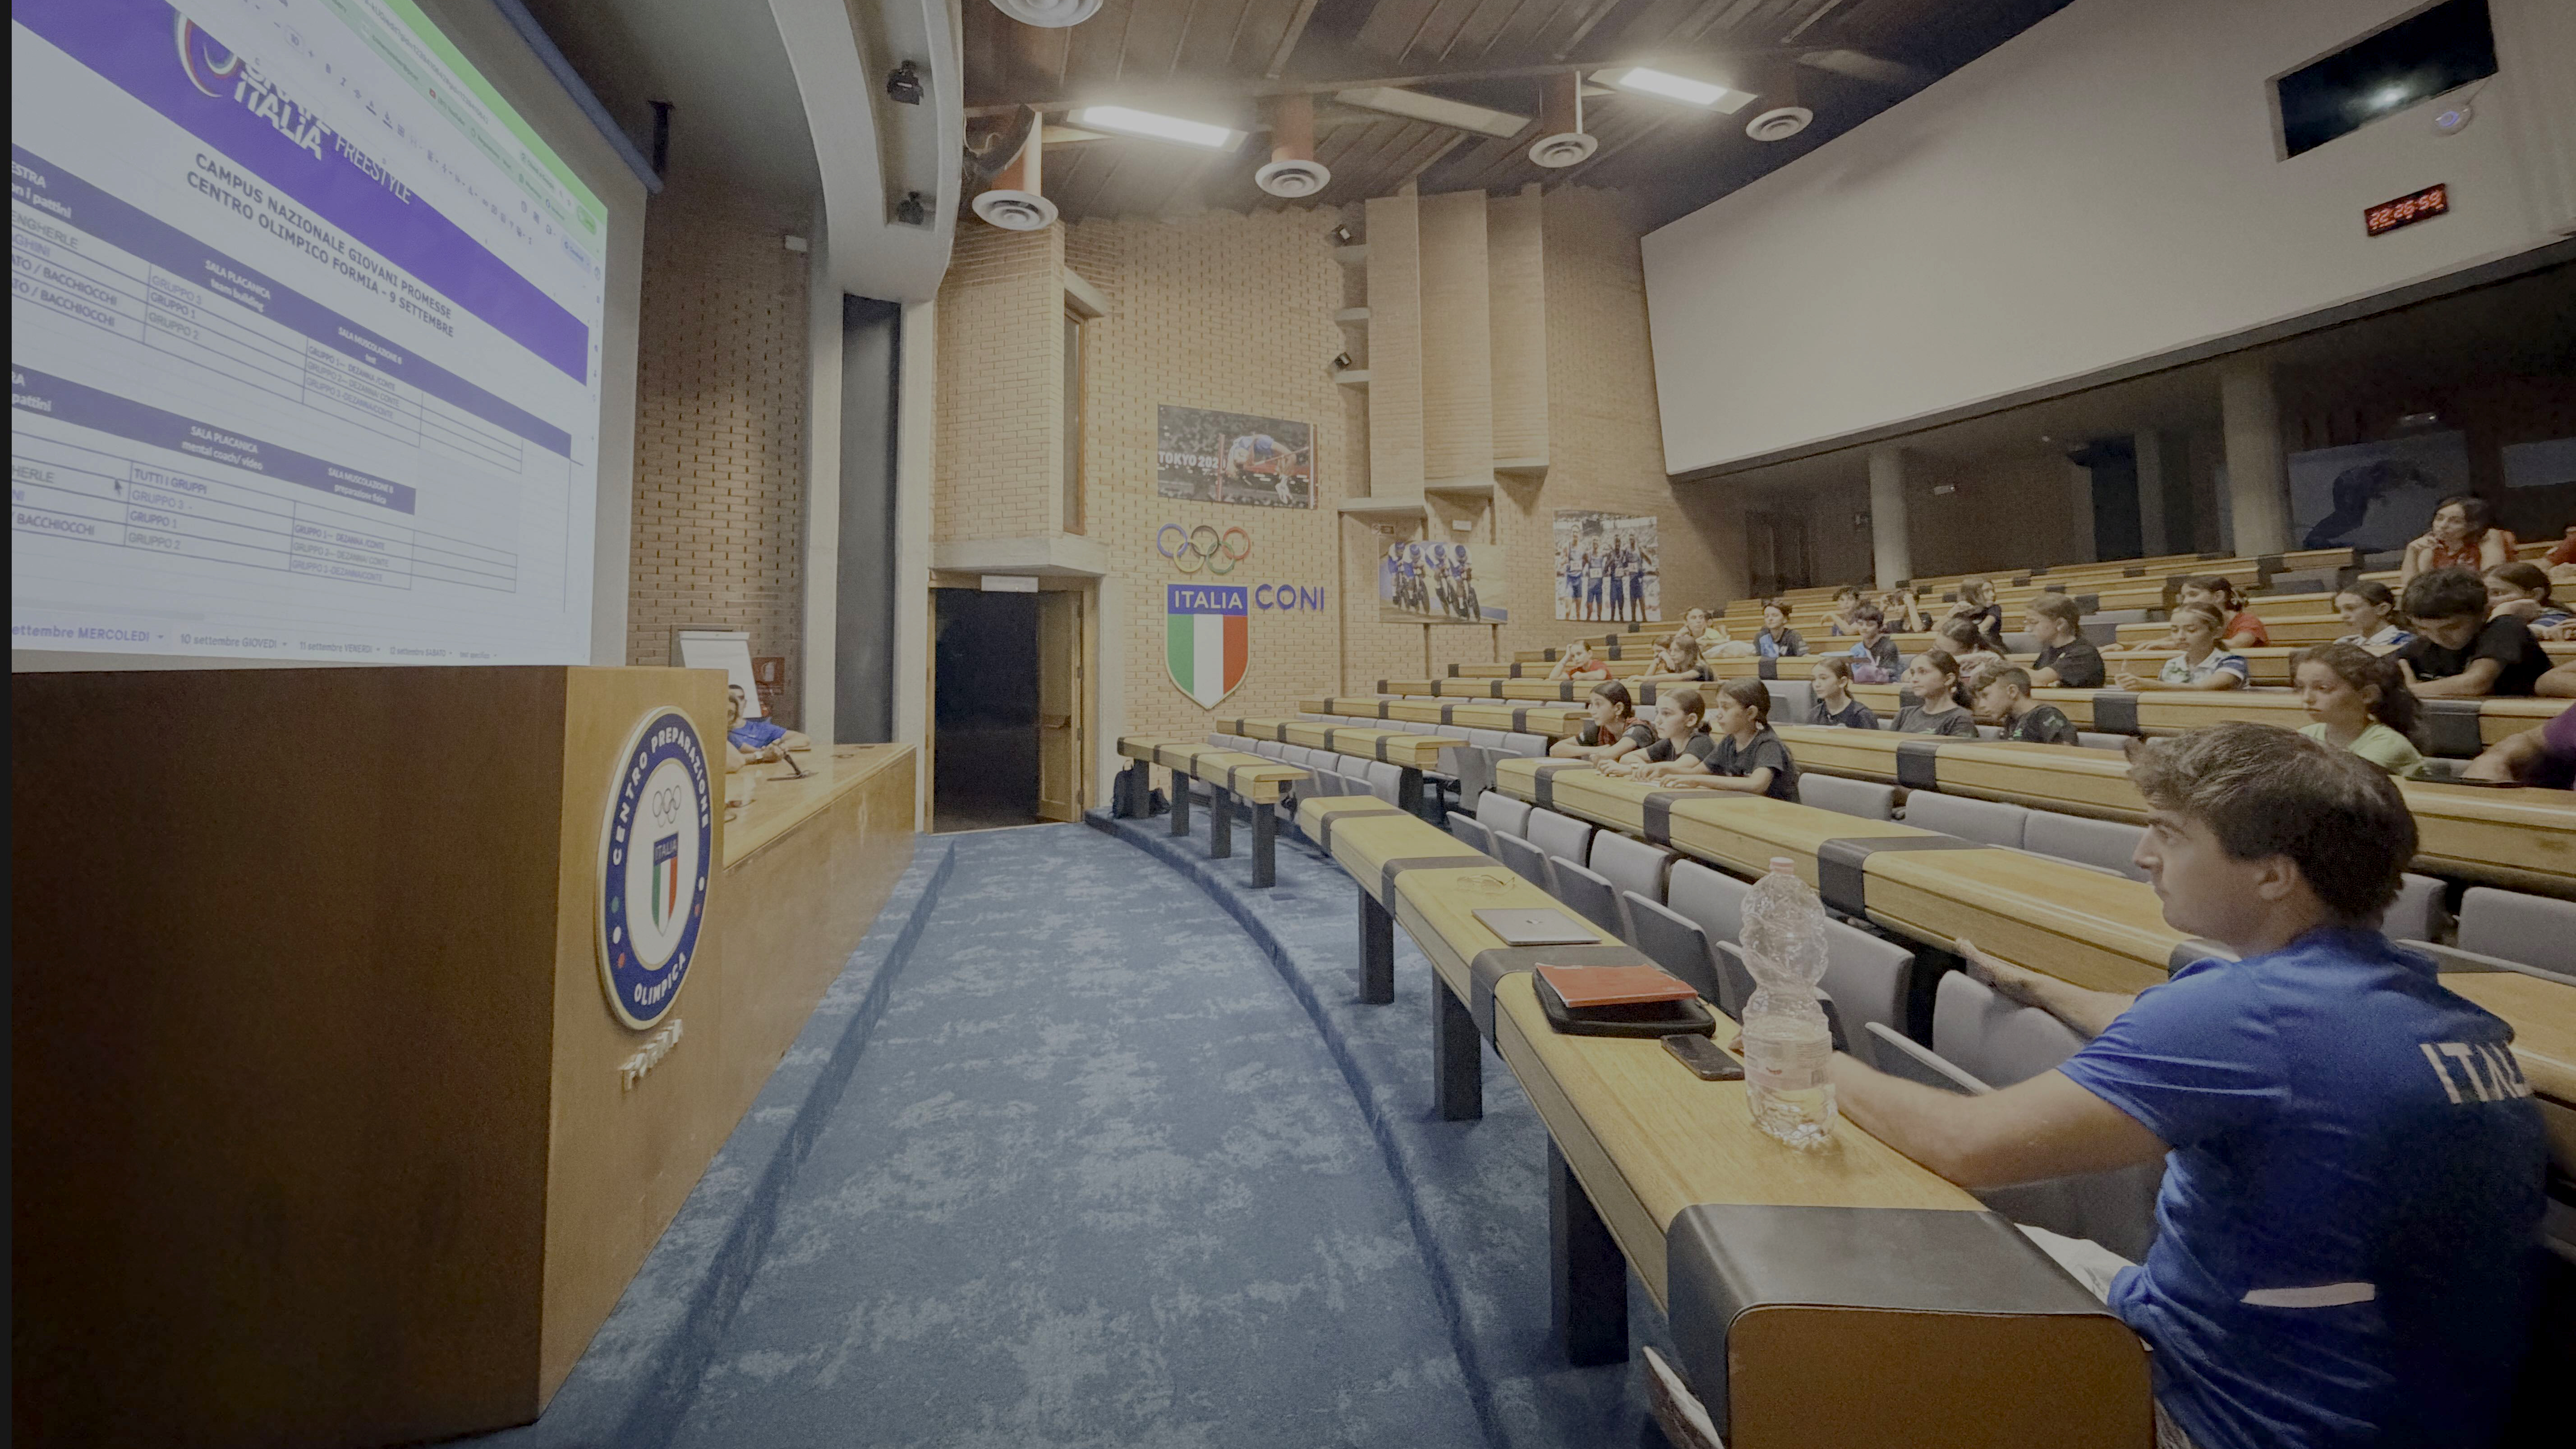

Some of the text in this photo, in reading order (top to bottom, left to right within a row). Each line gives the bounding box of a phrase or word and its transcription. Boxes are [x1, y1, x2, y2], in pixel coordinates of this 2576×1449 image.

[12, 160, 46, 189] ESTRA
[335, 136, 412, 205] FREESTYLE
[2369, 189, 2444, 230] 22:26:59
[12, 210, 78, 249] ENGHERLE
[195, 152, 451, 320] CAMPUS NAZIONALE GIOVANI PROMESSE
[12, 232, 50, 257] GHINI
[187, 170, 253, 220] CENTRO
[258, 213, 329, 264] OLIMPICO
[332, 257, 379, 294] FORMIA
[389, 291, 396, 304] 9
[399, 296, 454, 338] SETTEMBRE
[43, 267, 117, 306] BACCHIOCCHI
[152, 275, 202, 305] GRUPPO 3
[40, 290, 115, 327] BACCHIOCCHI
[151, 291, 195, 319] GRUPPO 1
[148, 312, 199, 340] GRUPPO 2
[308, 345, 335, 364] GRUPPO
[307, 361, 336, 381] GRUPPO
[306, 377, 335, 396] GRUPPO
[190, 426, 259, 454] SALA PLACANICA
[182, 441, 212, 456] mental
[241, 456, 263, 471] video
[1158, 451, 1197, 466] TOKYO
[12, 465, 55, 484] HERLE
[134, 468, 163, 484] TUTTI
[170, 477, 207, 495] GRUPPI
[132, 490, 176, 508] GRUPPO
[178, 500, 184, 510] 3
[16, 512, 95, 536] BACCHIOCCHI
[130, 511, 177, 529] GRUPPO 1
[294, 524, 322, 538] GRUPPO
[129, 532, 180, 550] GRUPPO 2
[294, 542, 323, 555] GRUPPO
[293, 559, 322, 573] GRUPPO
[1174, 590, 1243, 609] ITALIA
[1255, 584, 1325, 612] CONI
[12, 625, 74, 639] ettembre
[180, 634, 191, 644] 10
[193, 635, 240, 647] settembre
[299, 641, 306, 650] 11
[308, 642, 342, 653] settembre
[612, 727, 708, 866] CENTRO PREPARAZIONE
[655, 838, 678, 862] ITALIA
[634, 952, 686, 1006] OLIMPICA
